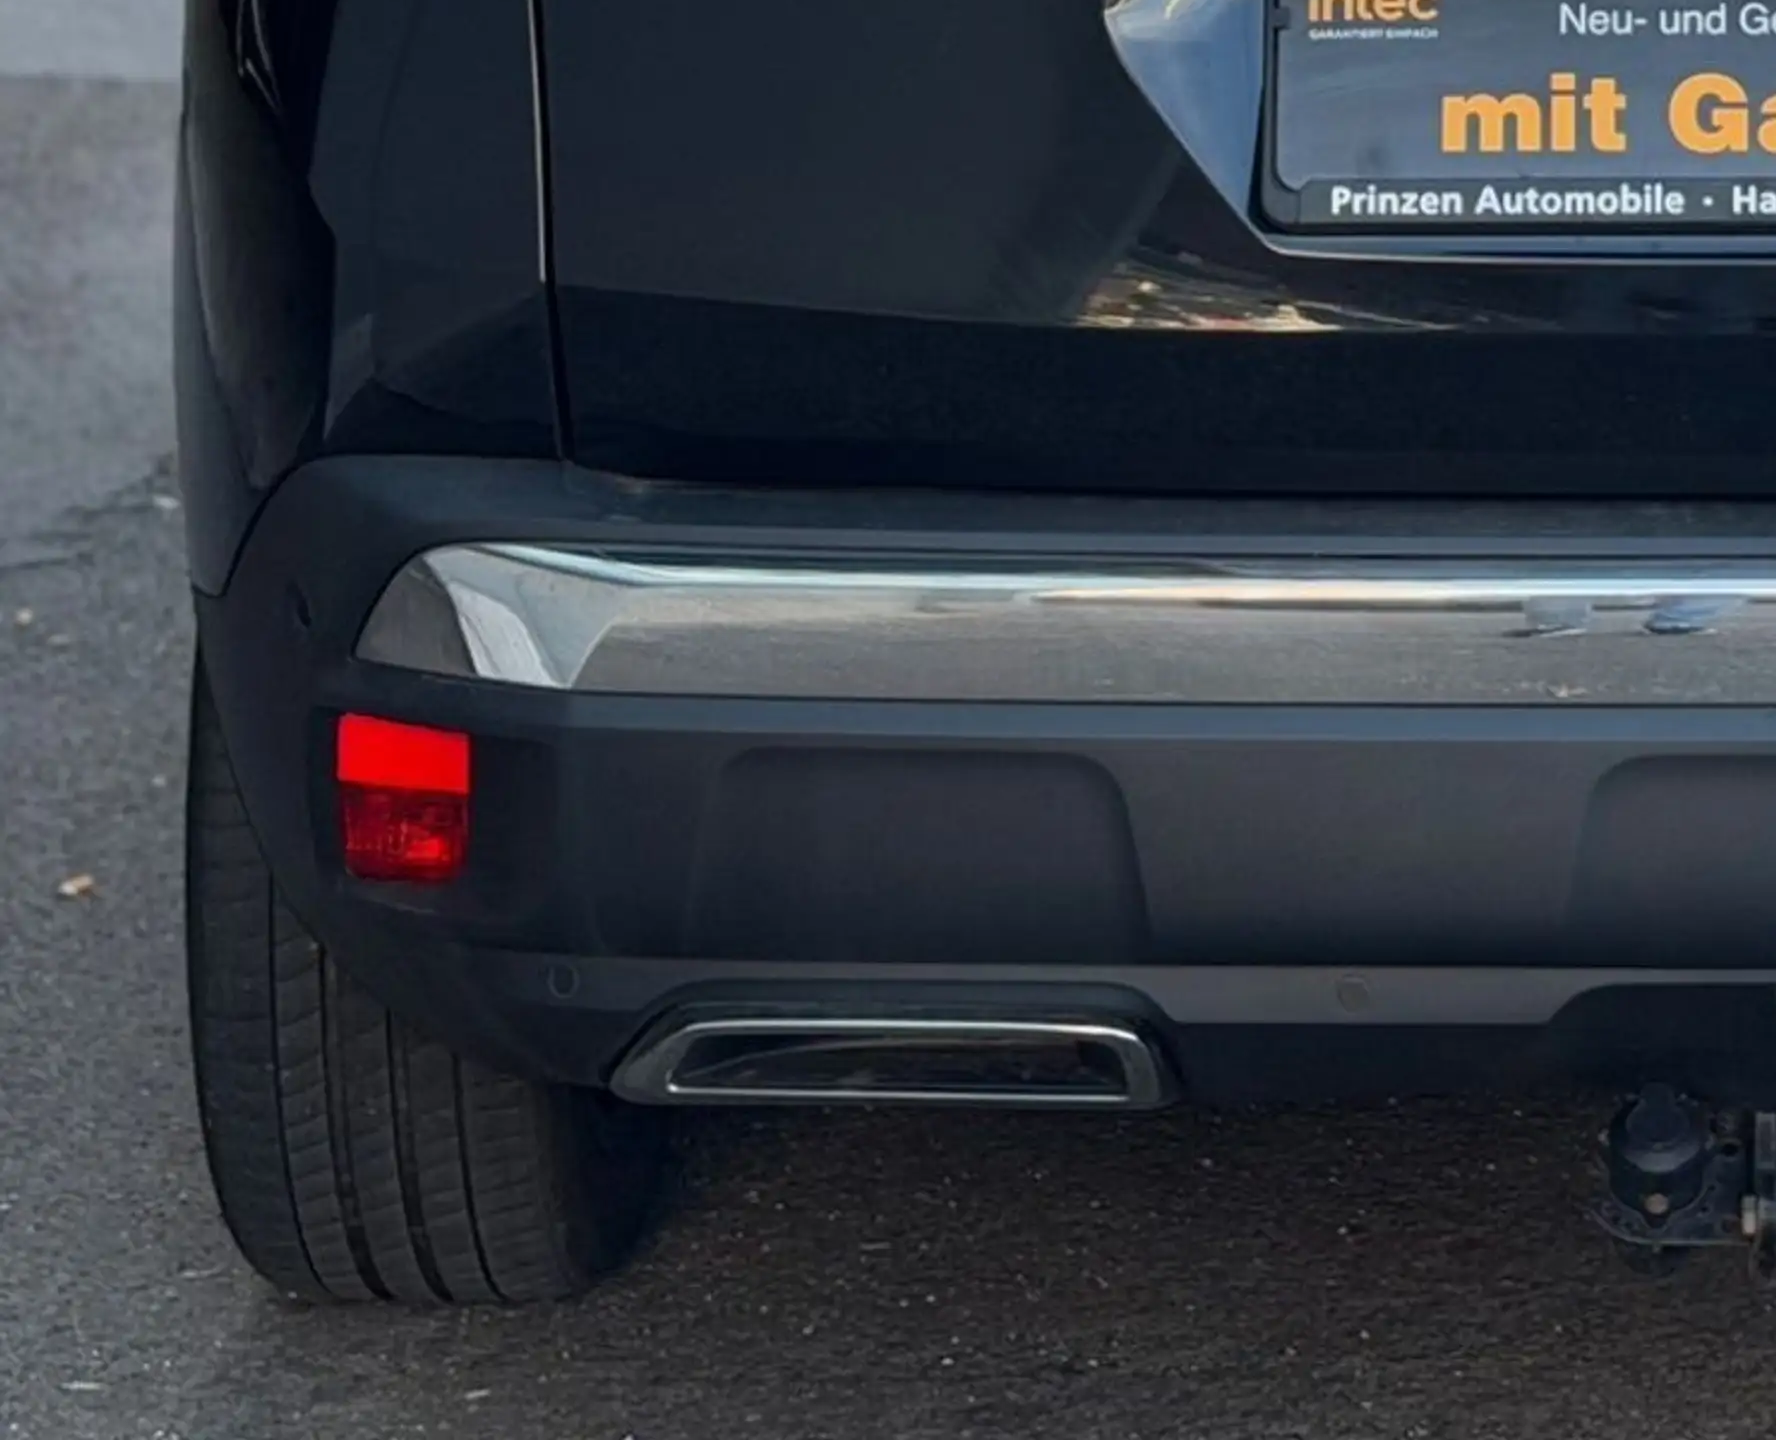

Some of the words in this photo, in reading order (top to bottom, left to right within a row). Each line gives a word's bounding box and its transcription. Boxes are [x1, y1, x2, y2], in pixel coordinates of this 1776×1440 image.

[1559, 3, 1647, 35] Neu-
[1659, 3, 1727, 34] und
[1441, 73, 1627, 153] mit
[1330, 187, 1464, 216] Prinzen
[1474, 185, 1686, 216] Automobile
